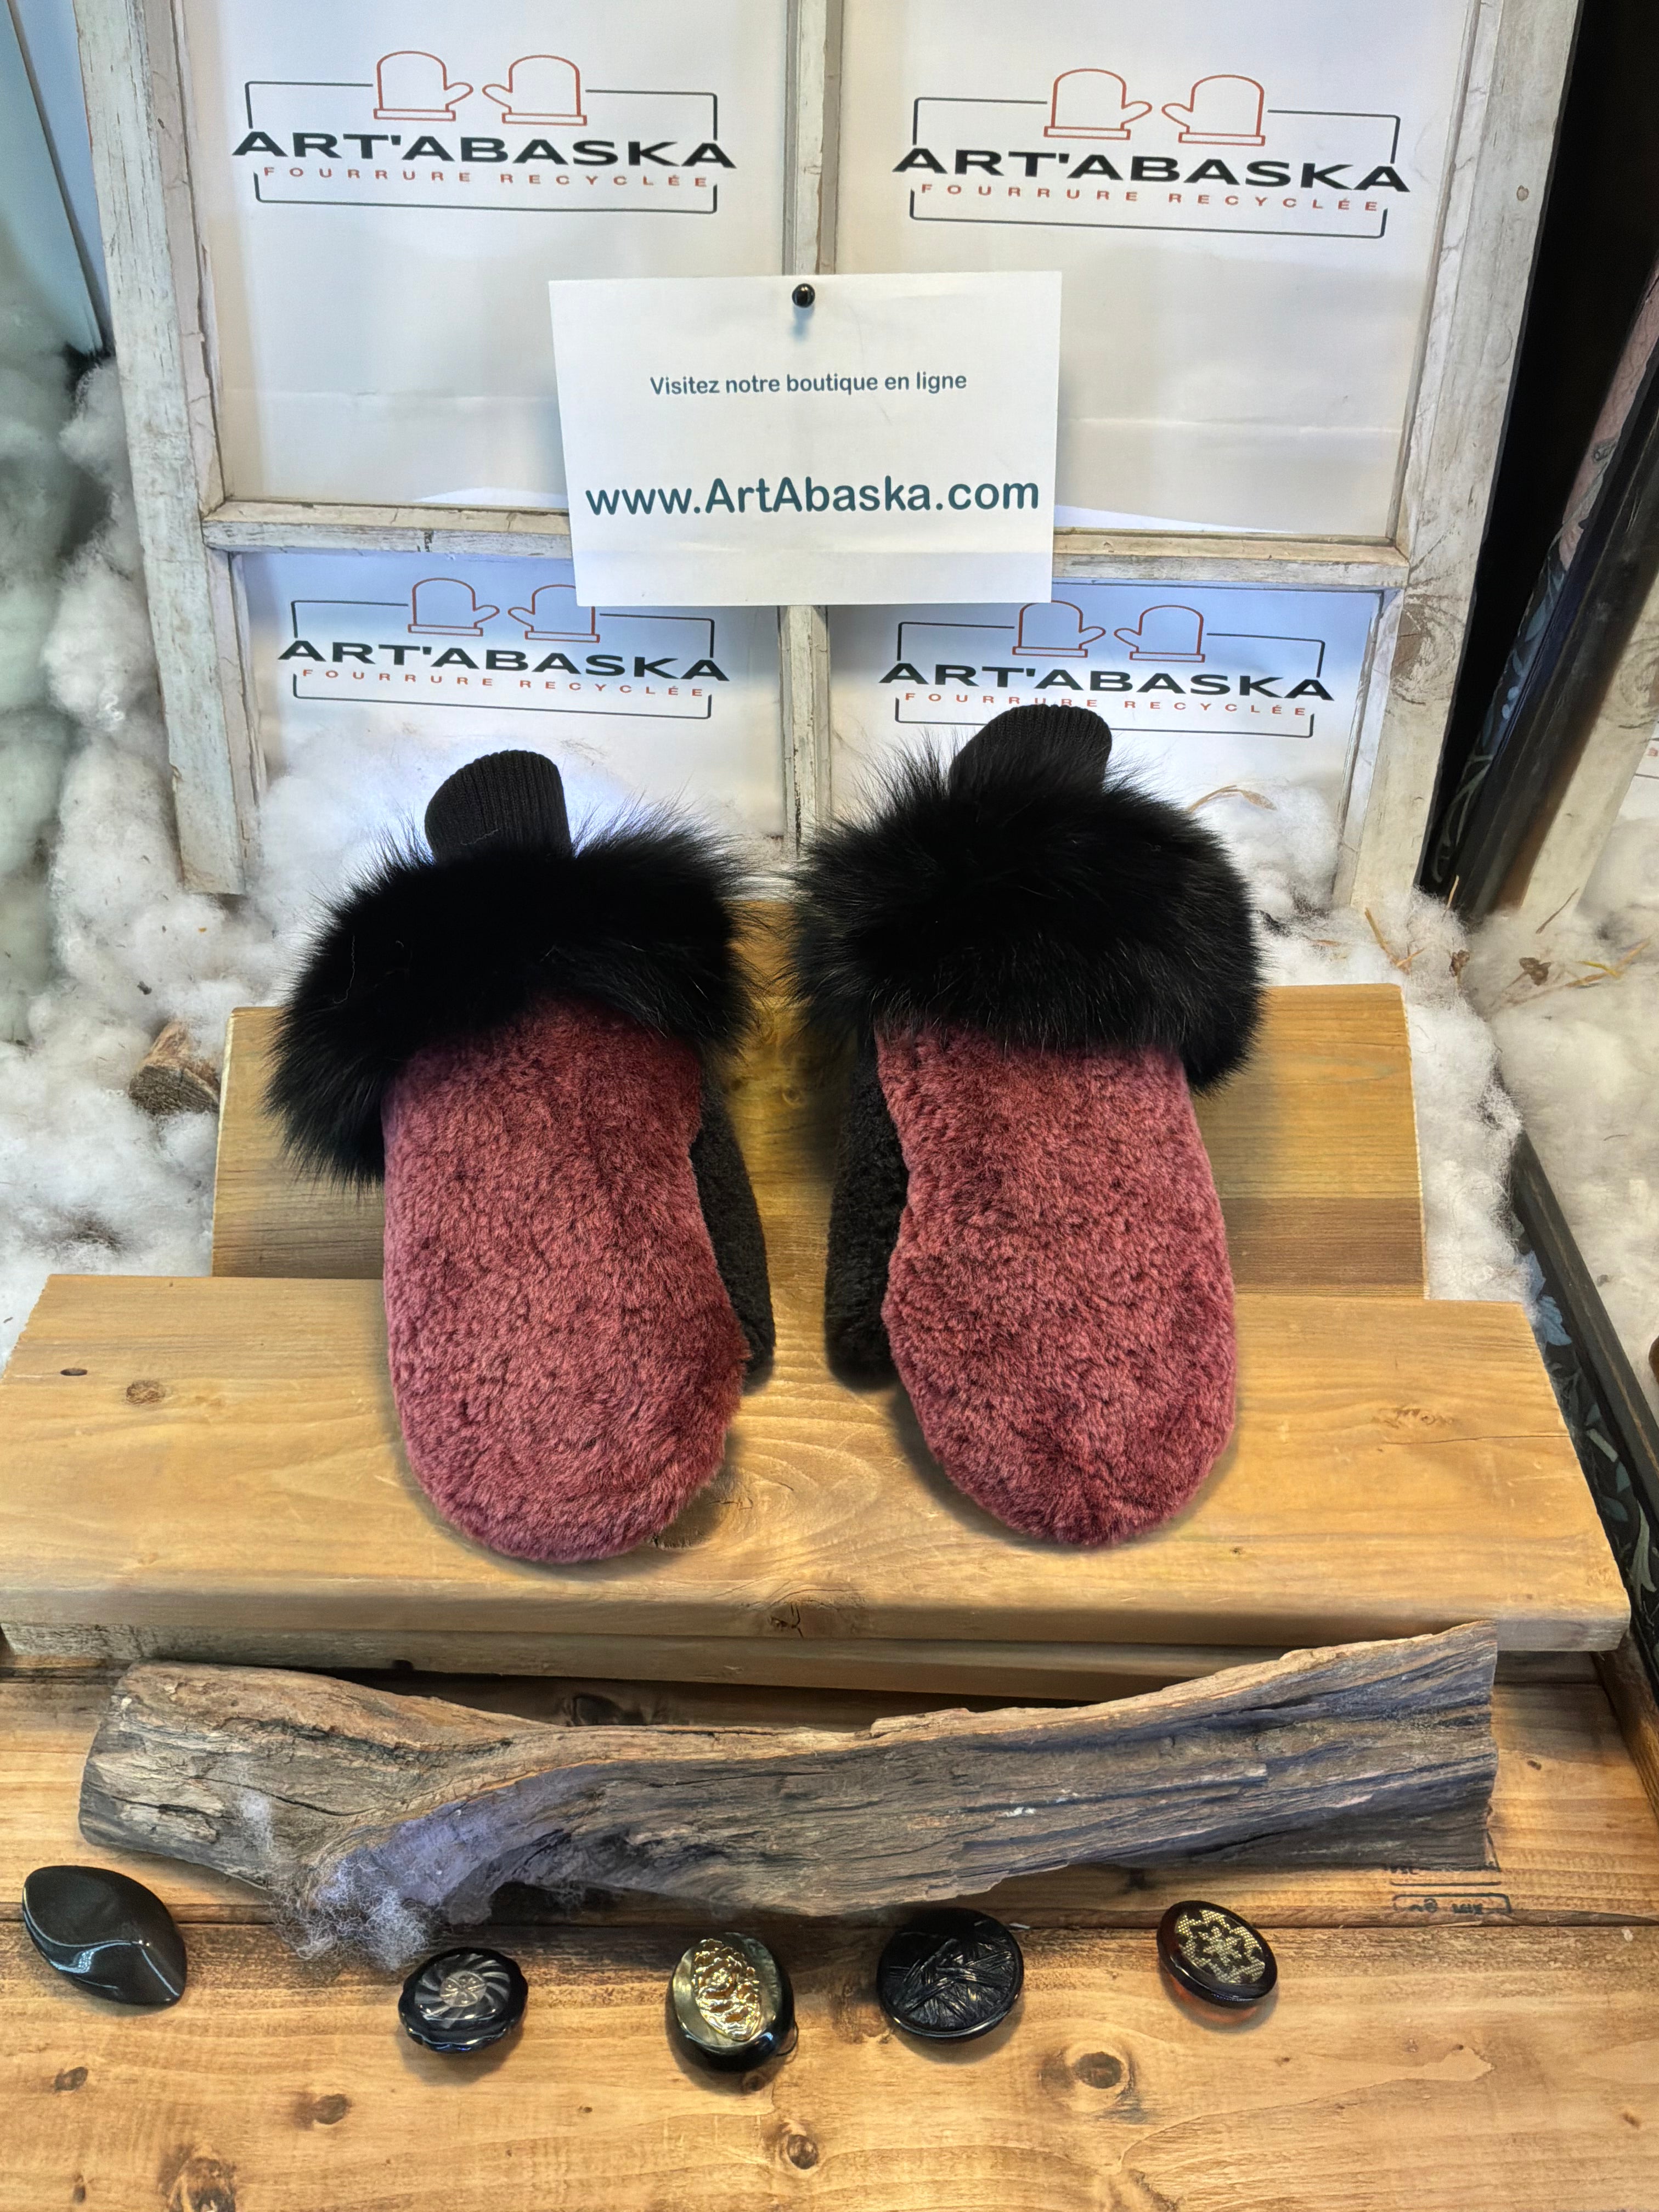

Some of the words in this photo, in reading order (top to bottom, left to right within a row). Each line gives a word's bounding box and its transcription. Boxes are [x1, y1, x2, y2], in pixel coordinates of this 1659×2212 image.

[232, 131, 736, 169] ART'ABASKA
[264, 167, 470, 183] FOURRURE
[500, 173, 708, 187] RECYCLÉE
[892, 148, 1410, 193] ART'ABASKA
[921, 184, 1138, 202] FOURRURE
[1169, 193, 1378, 212] RECYCLÉE
[650, 376, 720, 395] Visitez
[726, 375, 780, 393] notre
[787, 373, 878, 396] boutique
[884, 376, 910, 391] en
[916, 371, 967, 394] ligne
[585, 475, 1039, 516] www.ArtAbaska.com
[278, 640, 730, 682] ART'ABASKA
[302, 669, 493, 686] FOURRURE
[520, 680, 703, 697] RECYCLÉE
[878, 662, 1334, 701] ART'ABASKA
[905, 692, 1097, 707] FOURRURE
[1124, 701, 1306, 716] RECYCLÉE
